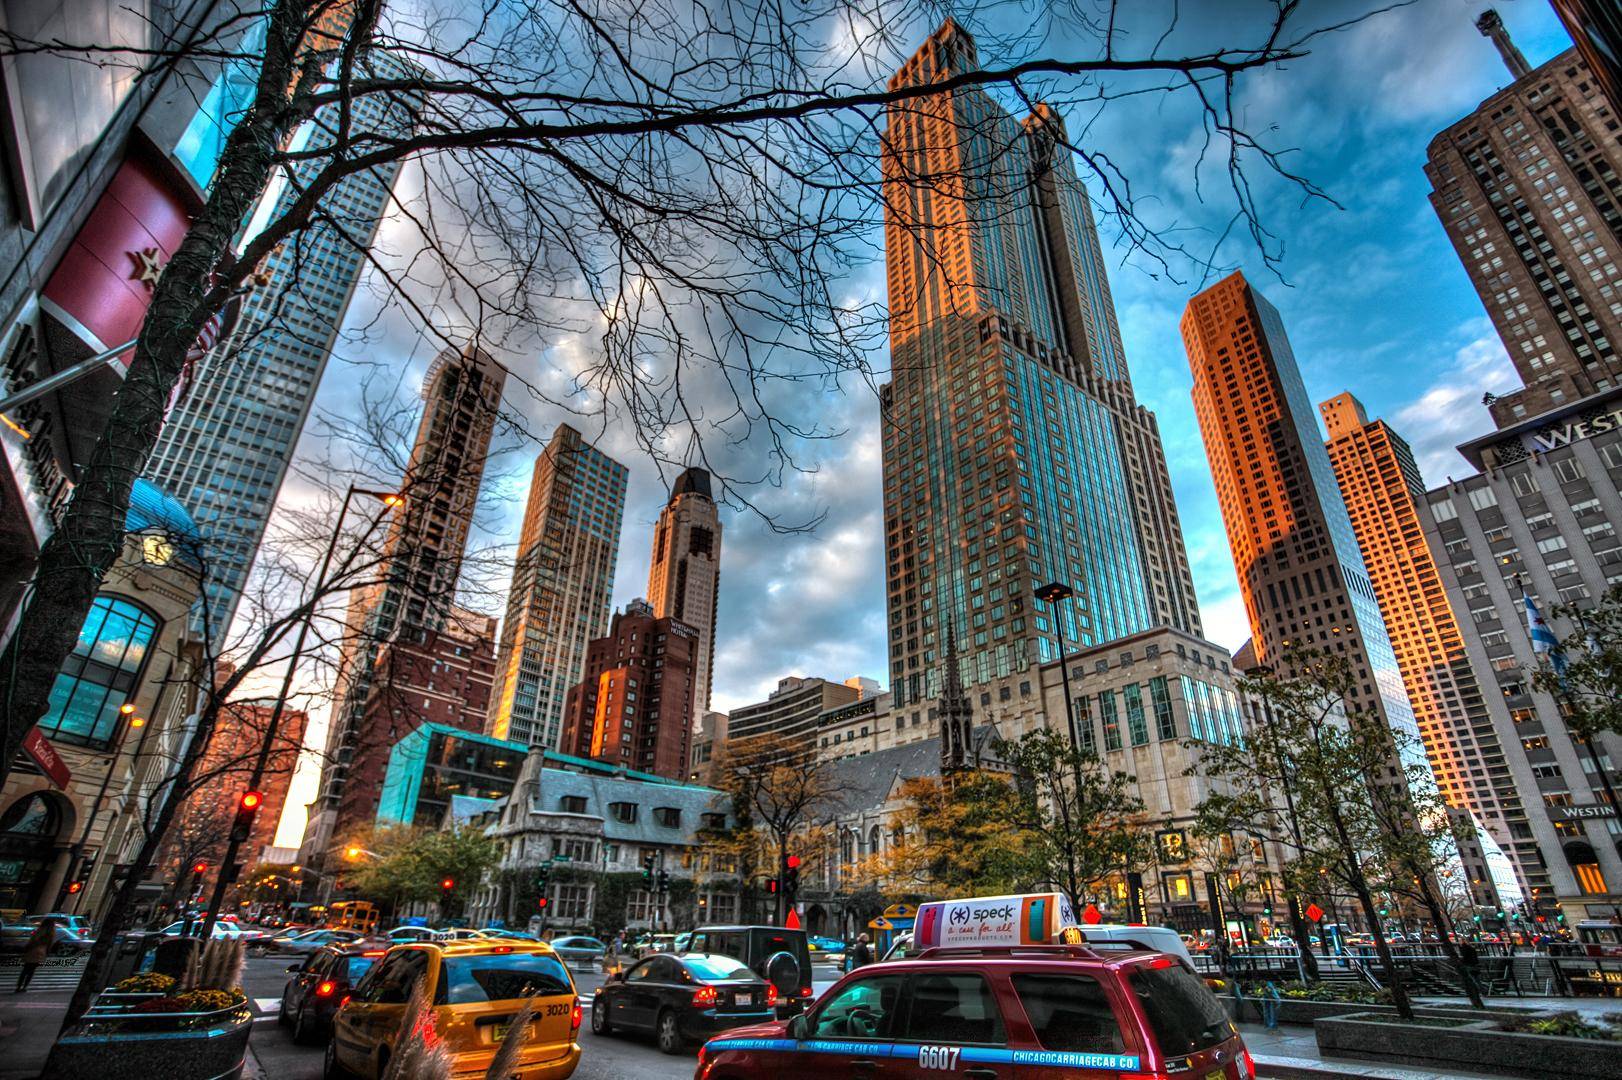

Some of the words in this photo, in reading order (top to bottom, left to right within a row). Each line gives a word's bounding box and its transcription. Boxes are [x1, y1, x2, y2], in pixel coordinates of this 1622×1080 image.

[1562, 806, 1616, 817] WESTIN
[973, 904, 1013, 923] speck
[978, 922, 991, 936] for
[995, 922, 1012, 932] all
[433, 933, 455, 941] 3020
[546, 1003, 570, 1017] 3020
[918, 1045, 961, 1071] 6607
[1119, 1057, 1138, 1069] CO.
